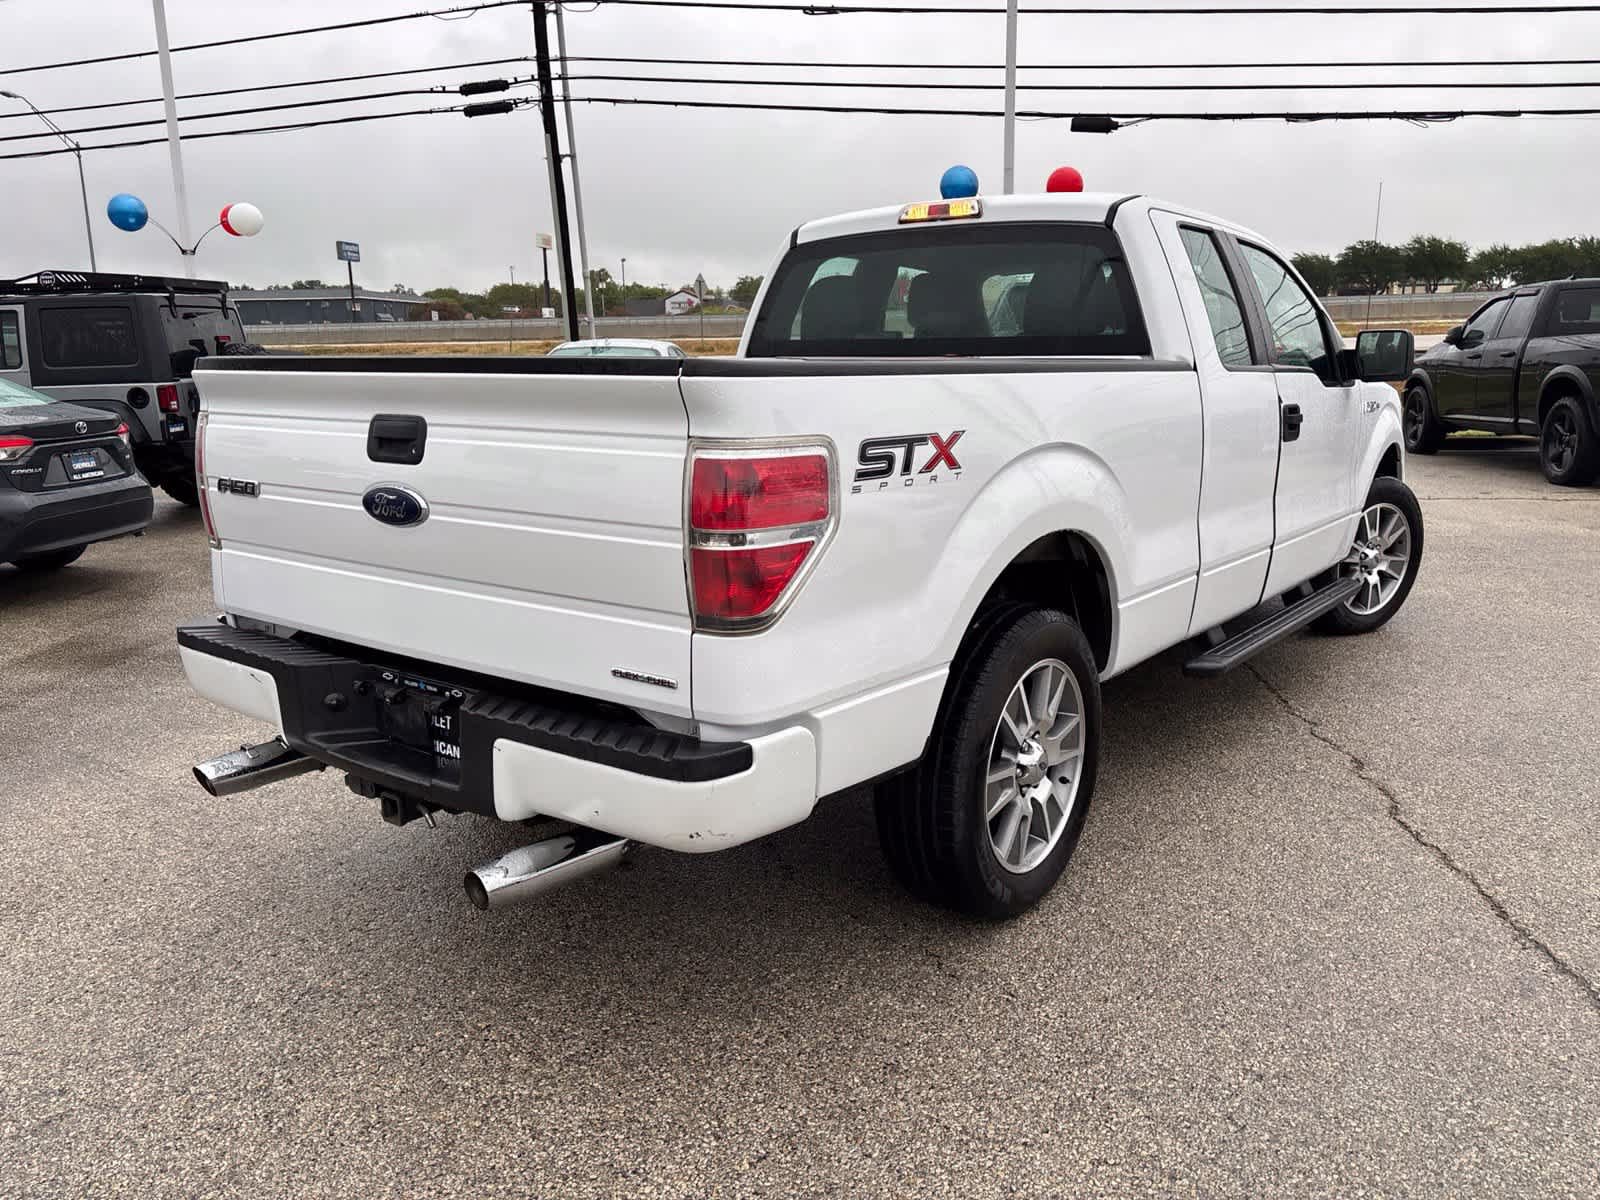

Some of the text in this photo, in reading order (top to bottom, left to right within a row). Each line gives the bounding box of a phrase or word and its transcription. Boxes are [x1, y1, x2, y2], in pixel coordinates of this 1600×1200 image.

[852, 430, 966, 482] STX
[851, 472, 962, 494] SPORT
[371, 493, 407, 519] Ford
[434, 739, 461, 759] ICAN
